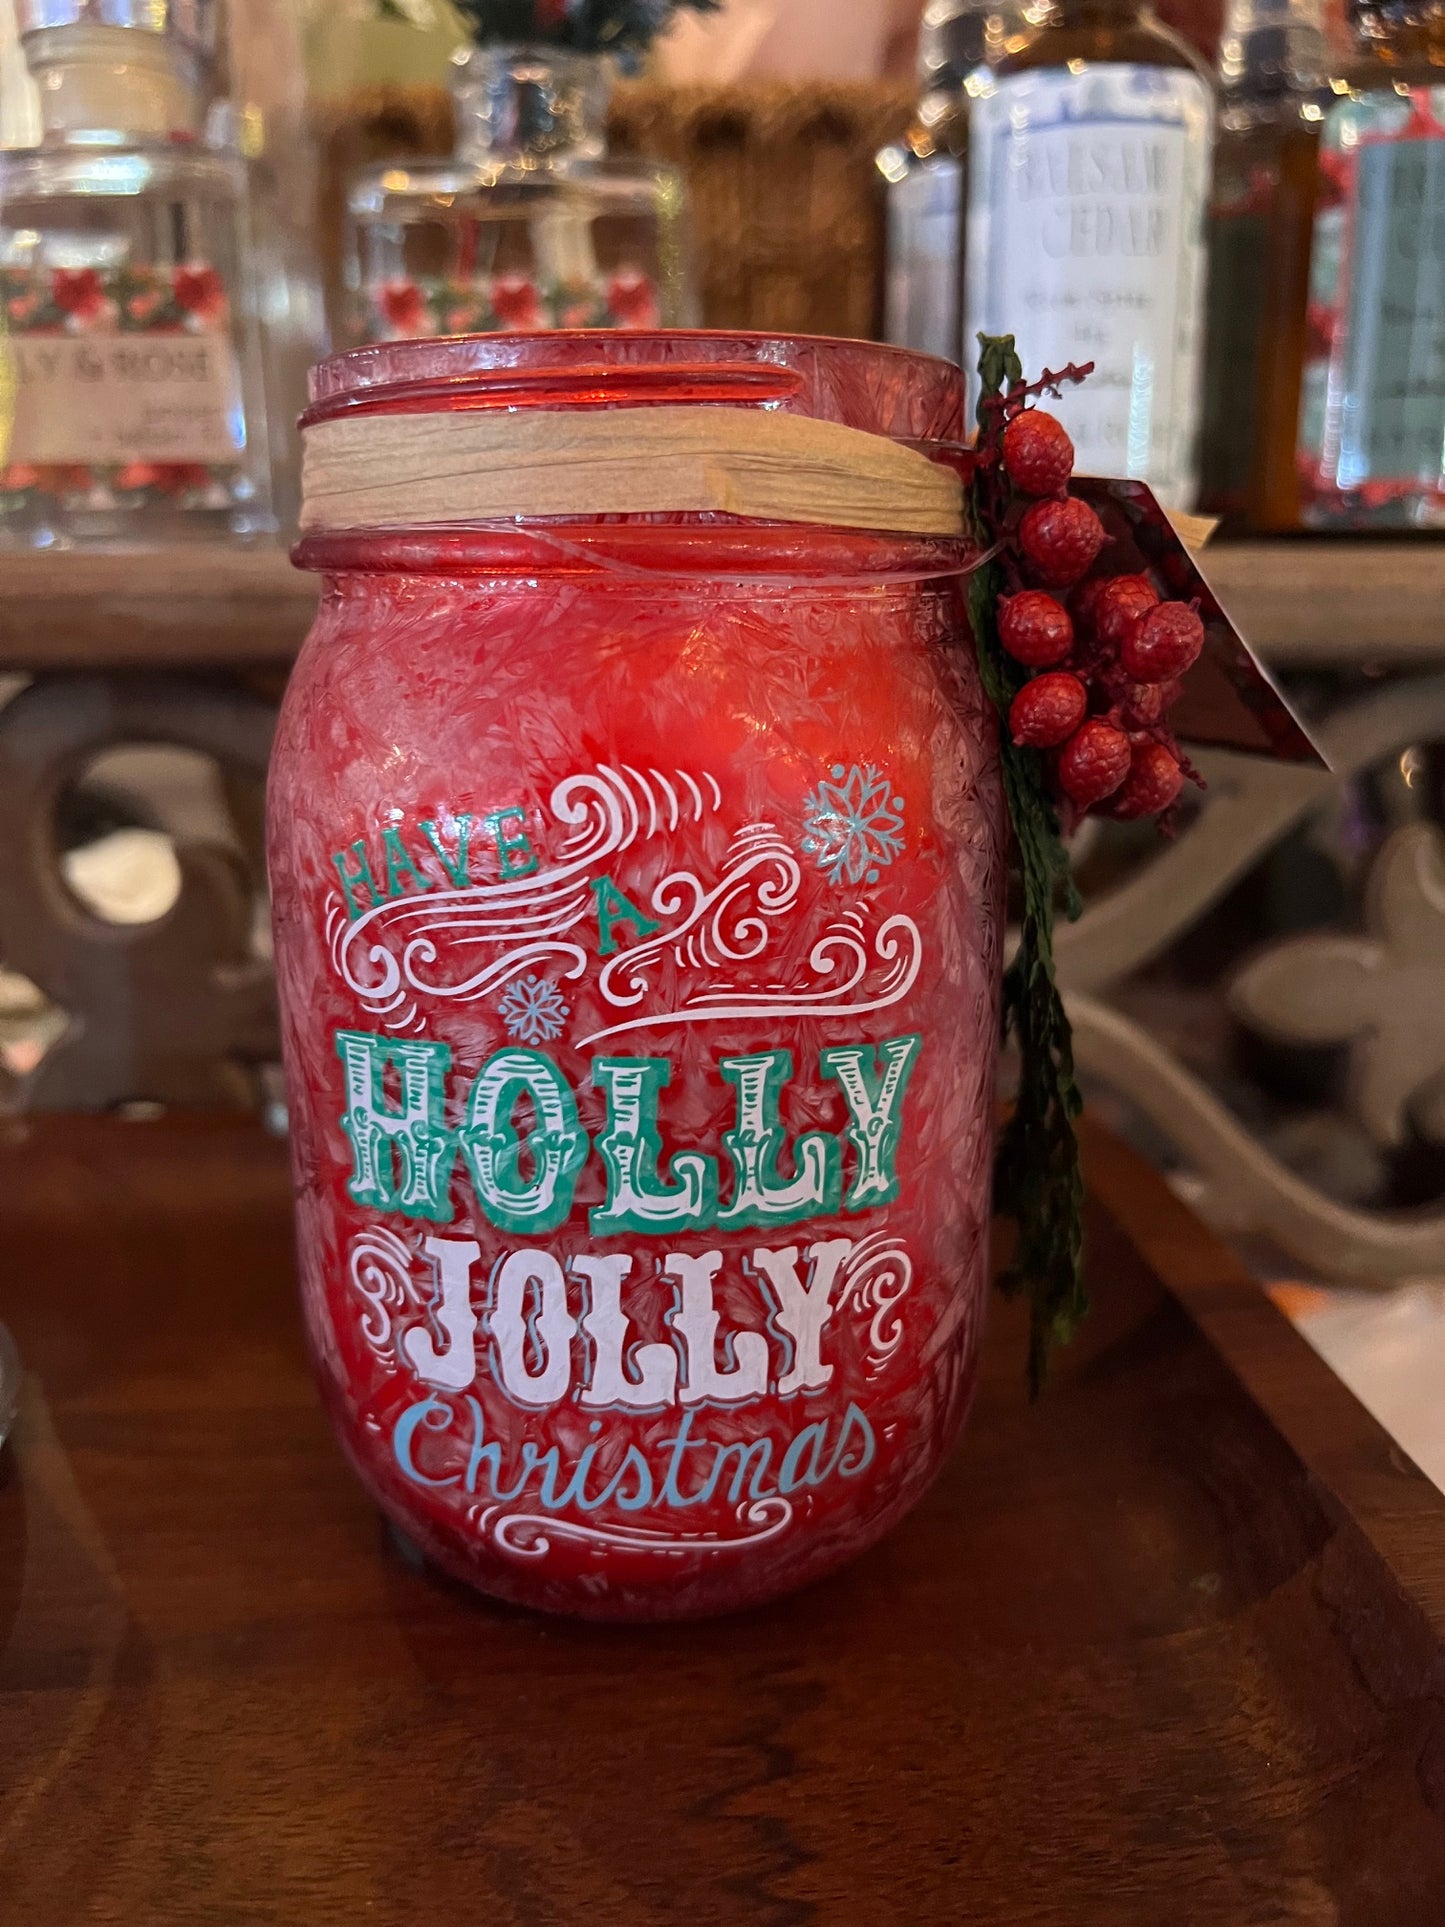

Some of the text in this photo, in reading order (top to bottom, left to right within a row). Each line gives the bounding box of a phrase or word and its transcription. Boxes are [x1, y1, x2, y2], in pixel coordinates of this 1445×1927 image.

[334, 806, 660, 956] HAVE A
[336, 1031, 920, 1232] HOLLY
[402, 1237, 853, 1411] JOLLY
[394, 1394, 875, 1510] Christmas
